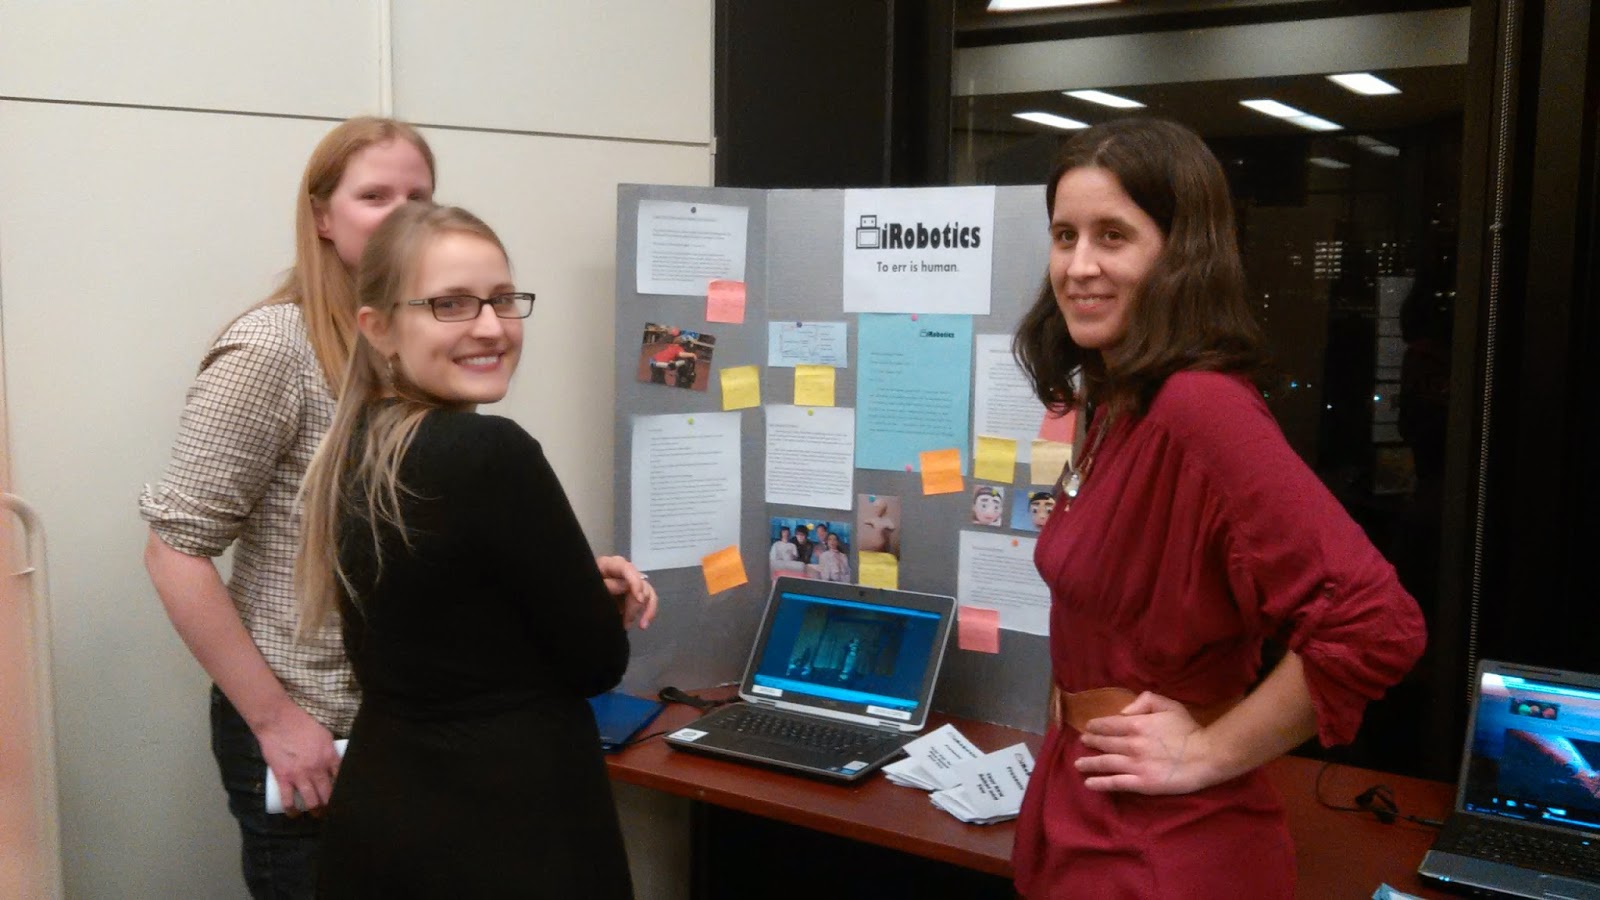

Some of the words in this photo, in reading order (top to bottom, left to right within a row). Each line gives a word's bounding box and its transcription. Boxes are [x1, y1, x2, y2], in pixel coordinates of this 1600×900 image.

[881, 222, 980, 249] iRobotics
[877, 261, 889, 272] To
[892, 263, 907, 272] err
[910, 261, 918, 272] is
[921, 260, 960, 272] human.
[926, 330, 955, 339] iRobotics
